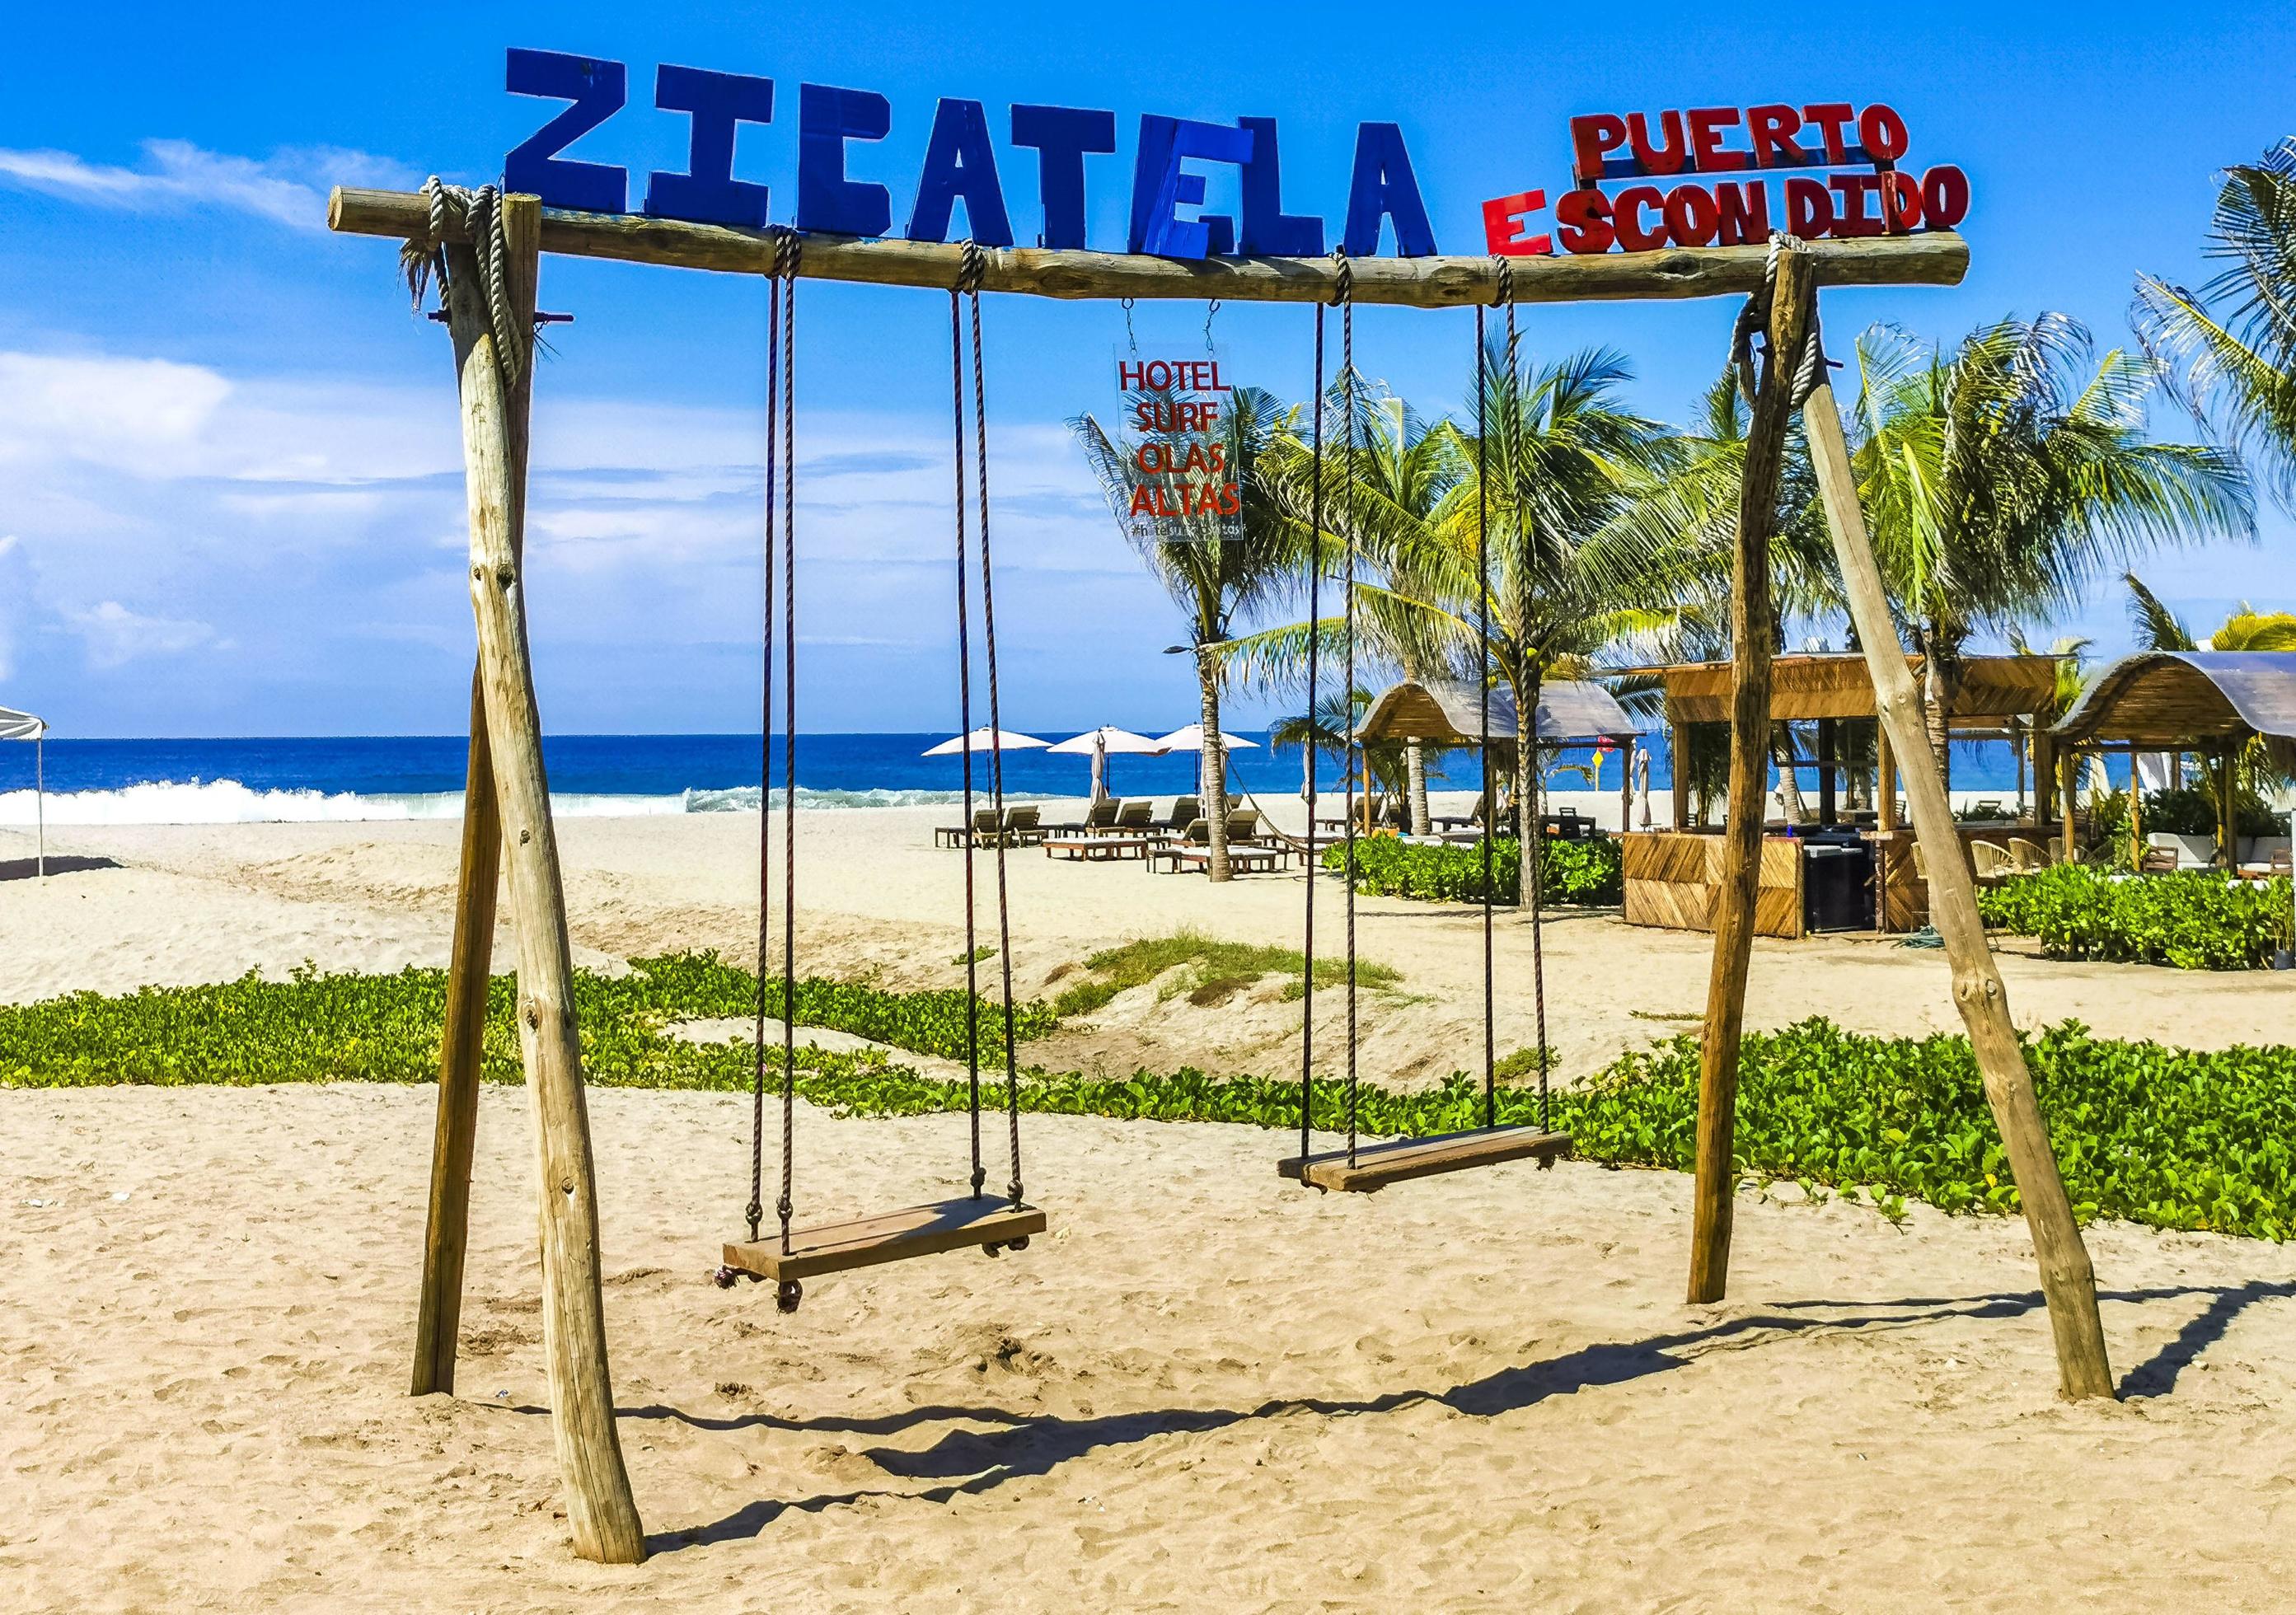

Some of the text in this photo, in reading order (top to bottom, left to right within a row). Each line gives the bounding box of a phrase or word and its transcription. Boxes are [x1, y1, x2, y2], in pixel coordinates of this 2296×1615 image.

[504, 47, 1436, 259] ZICATELA
[1570, 103, 1909, 179] PUERTO
[1482, 165, 1970, 255] ESCONDIDO
[1118, 361, 1231, 391] HOTEL
[1136, 401, 1219, 433] SURF
[1137, 442, 1225, 475] OLAS
[1131, 483, 1240, 517] ALTAS
